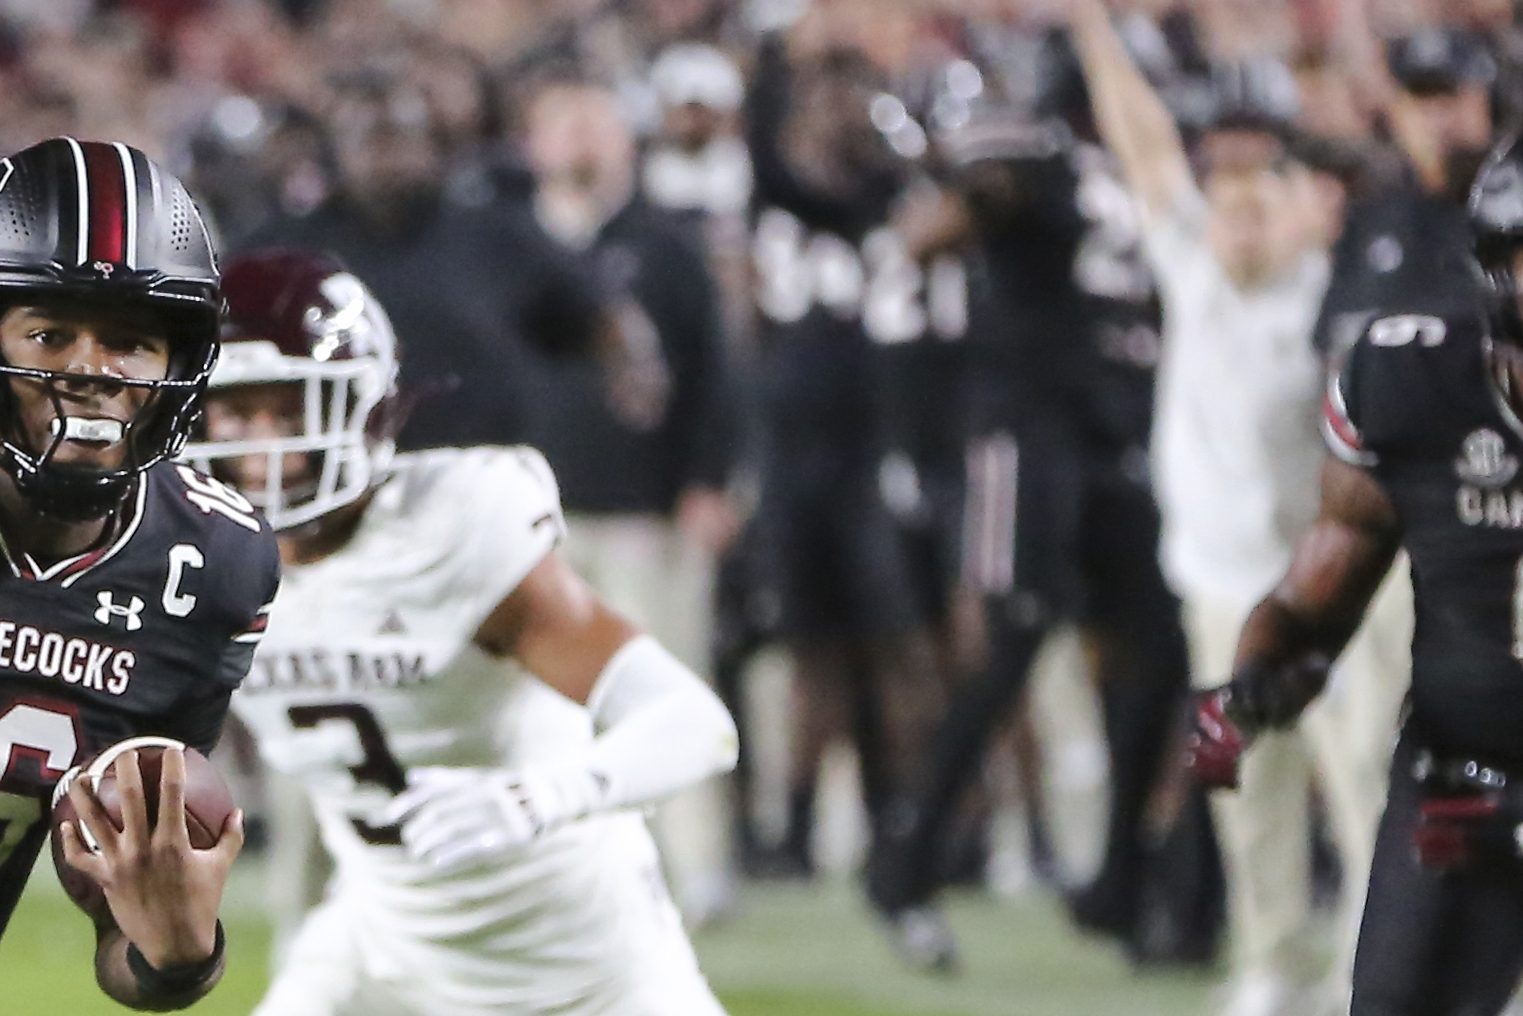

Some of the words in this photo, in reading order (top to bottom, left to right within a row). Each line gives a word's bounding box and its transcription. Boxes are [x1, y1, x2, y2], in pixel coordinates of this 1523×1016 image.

[176, 464, 262, 533] 16
[162, 543, 205, 618] C
[287, 702, 407, 847] 3
